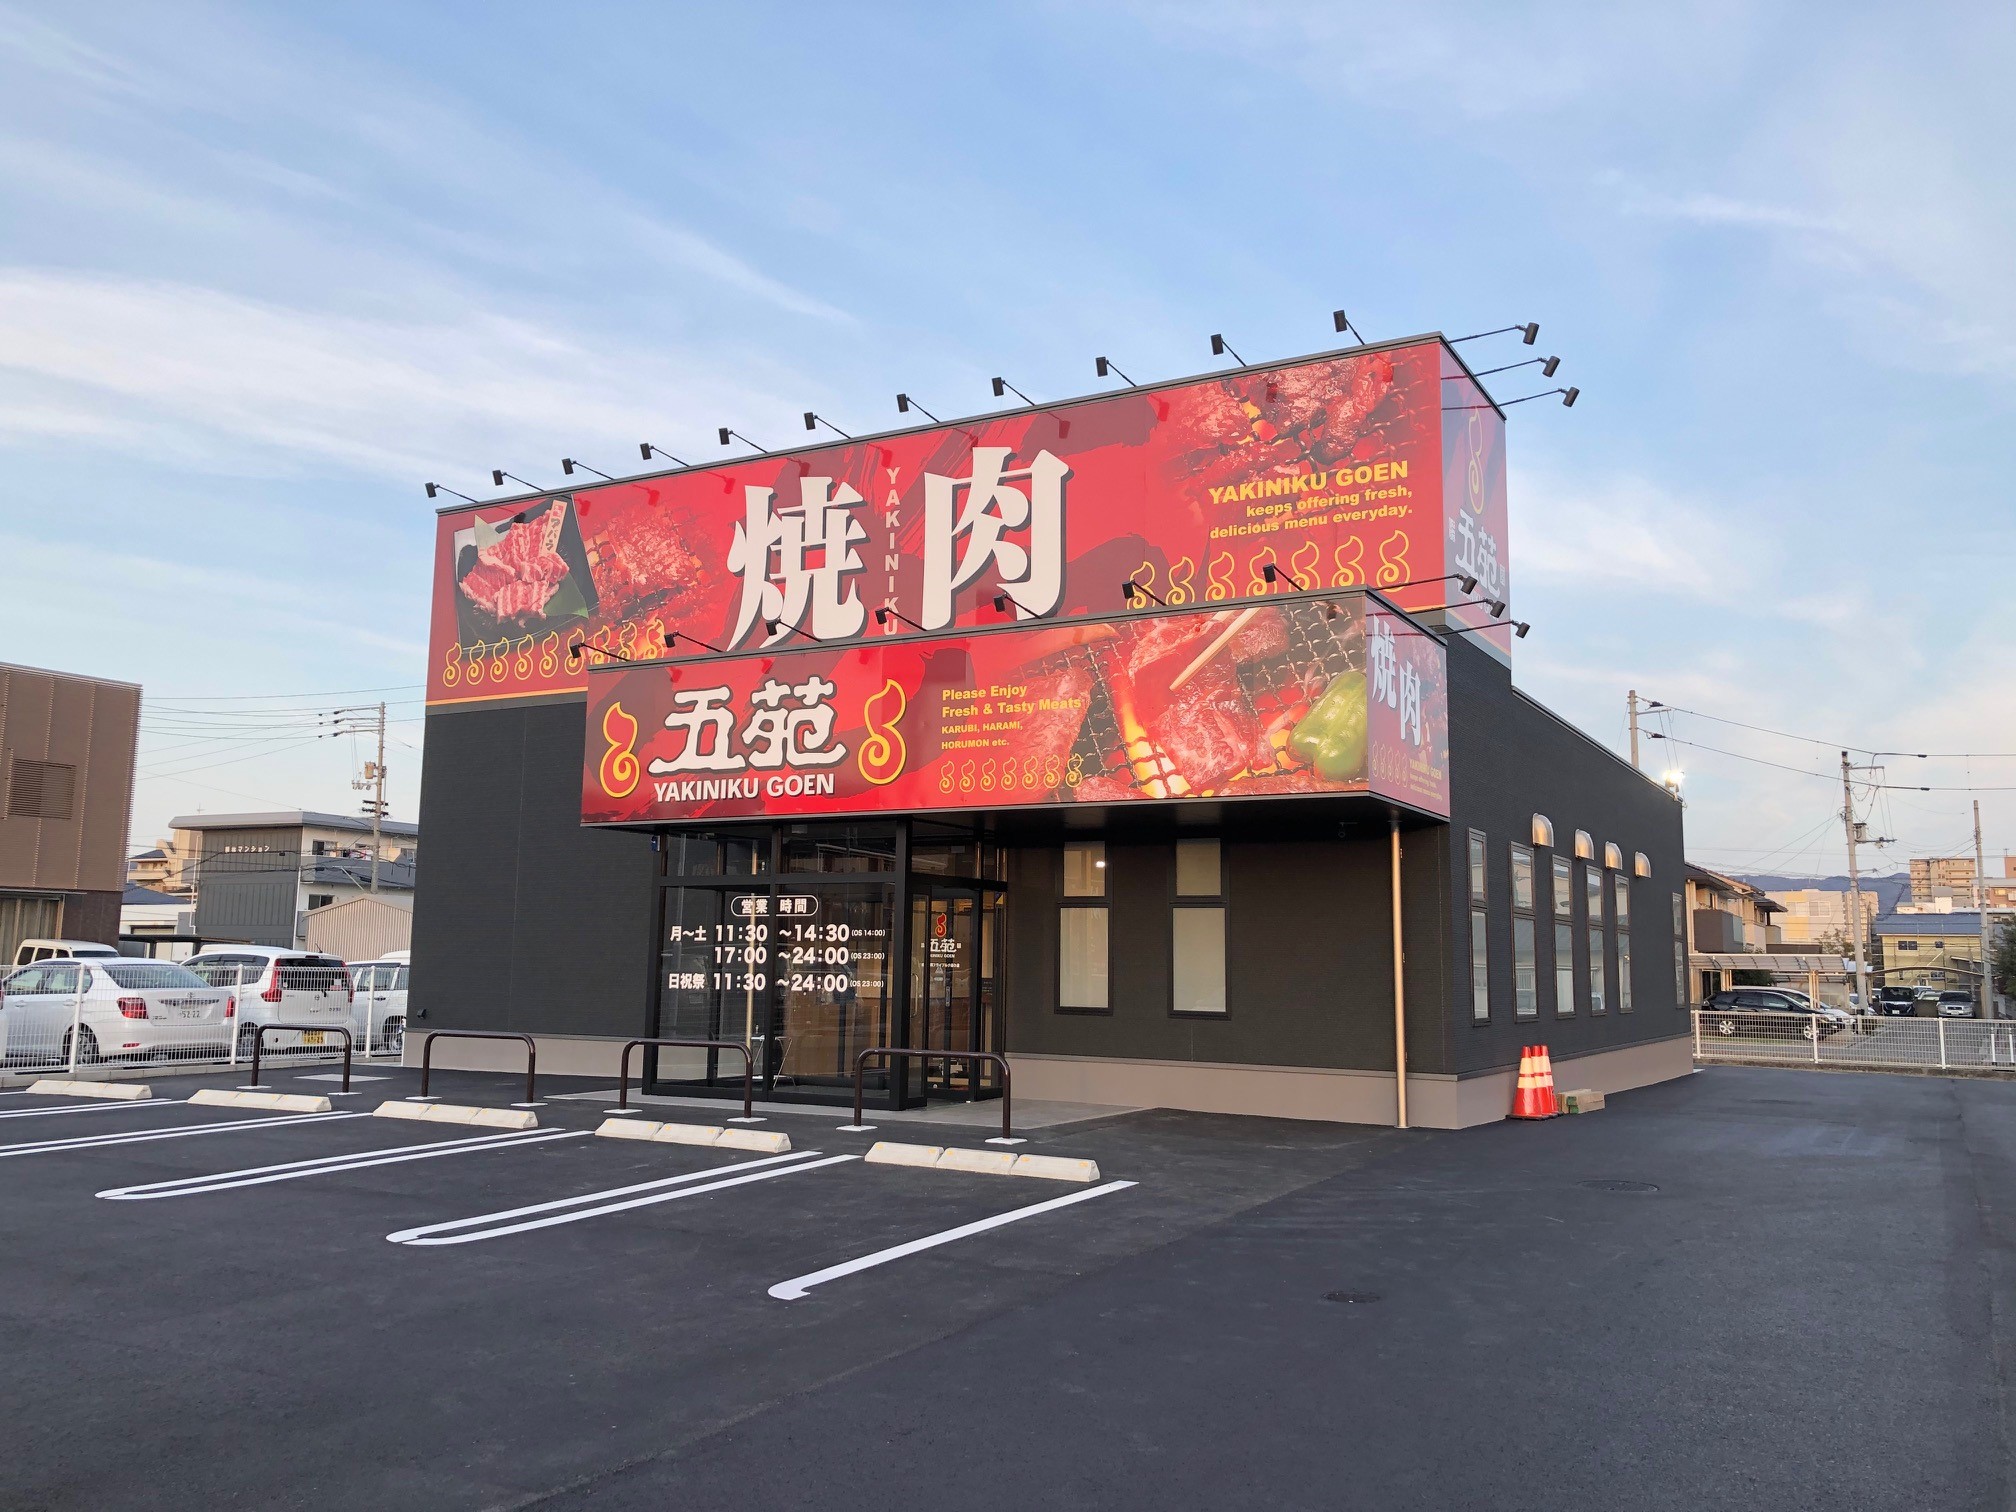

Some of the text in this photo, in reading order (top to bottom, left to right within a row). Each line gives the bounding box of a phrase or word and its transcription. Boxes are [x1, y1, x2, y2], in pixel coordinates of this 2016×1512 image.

[1208, 460, 1408, 504] YAKINIKU GOEN
[1246, 484, 1412, 517] keeps offering fresh,
[1210, 504, 1413, 539] delicious menu everyday.
[884, 467, 900, 635] YAKINIKU
[1455, 508, 1501, 598] 五苑
[942, 684, 1027, 701] Please Enjoy
[1371, 613, 1421, 746] 焼肉
[942, 697, 1081, 718] Fresh & Tasty Meats
[648, 676, 847, 774] 五苑
[941, 721, 1023, 734] KARUBI, HARAMI,
[941, 738, 1010, 749] HORUMON etc.
[653, 773, 835, 802] YAKINIKU GOEN
[715, 924, 768, 942] 11:30
[714, 947, 767, 964] 17:00
[668, 973, 705, 989] 日祝祭
[713, 973, 766, 990] 11:30
